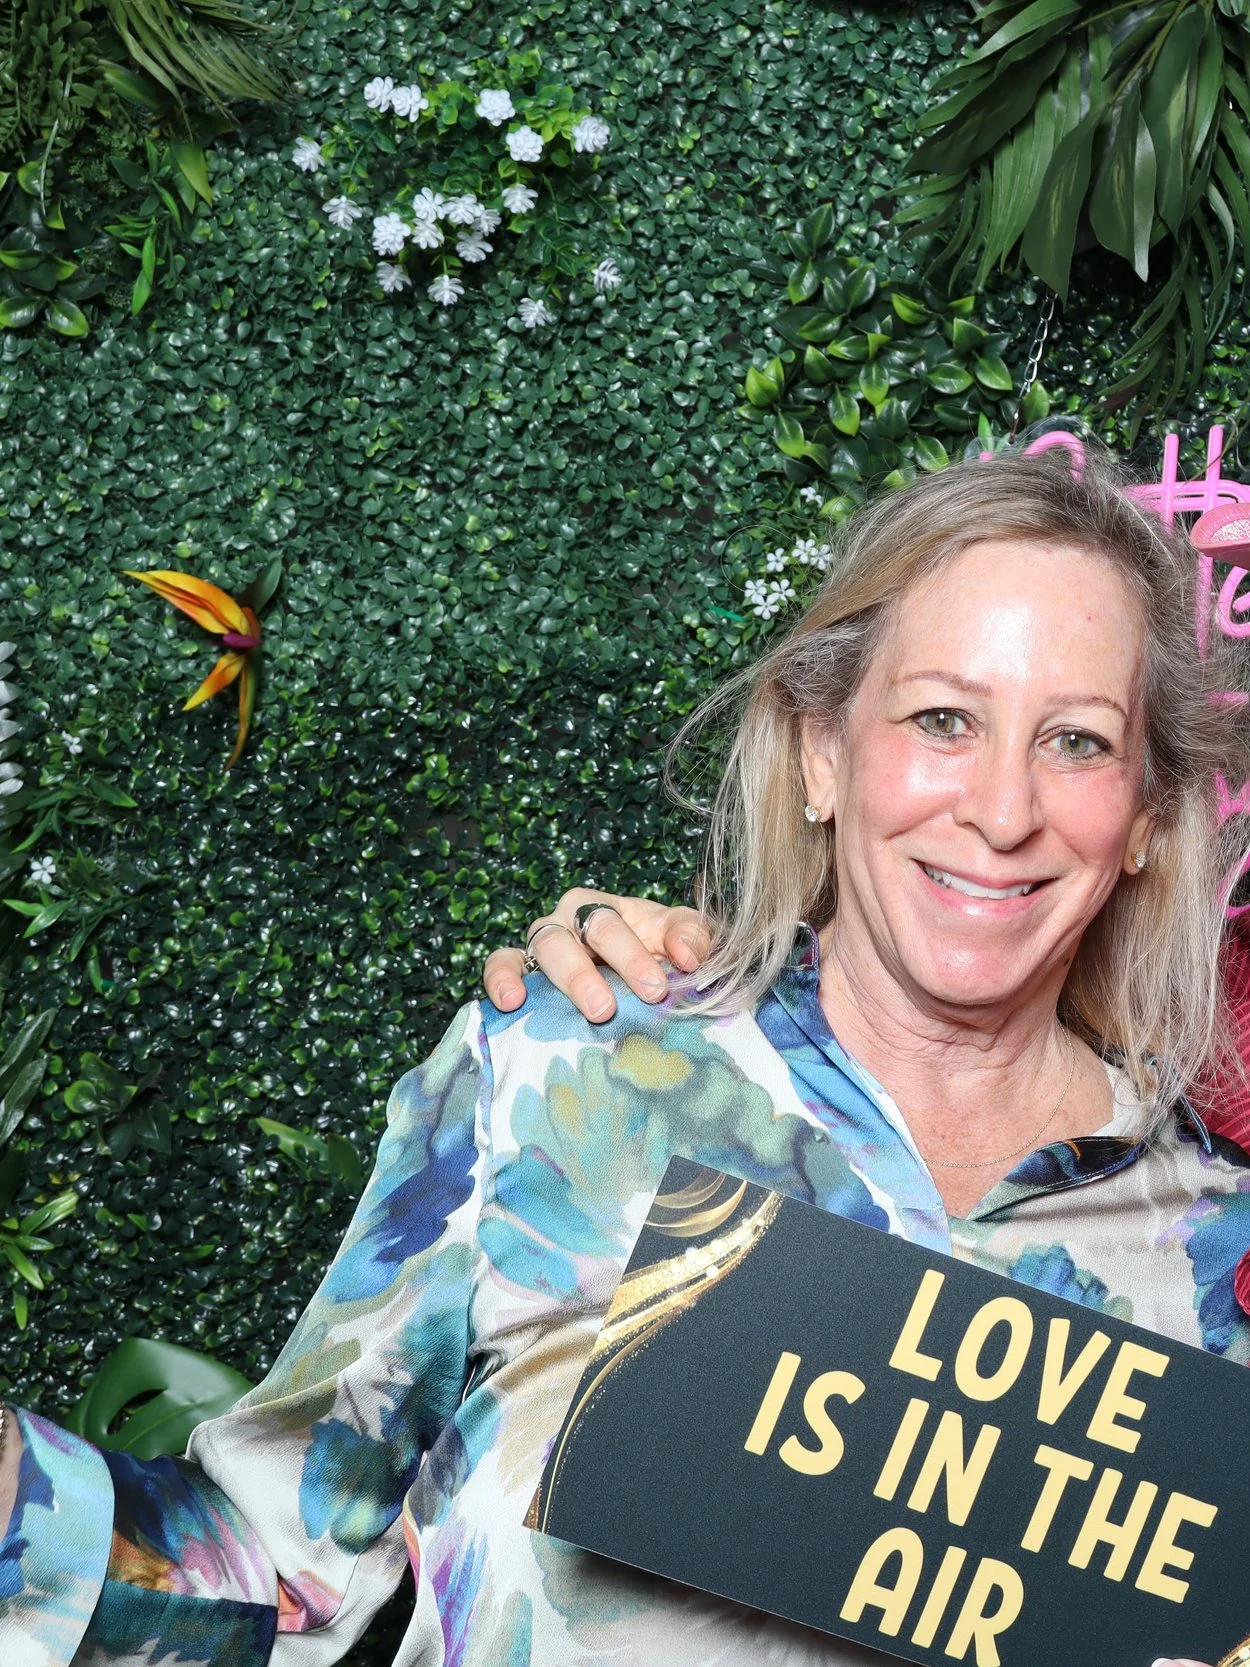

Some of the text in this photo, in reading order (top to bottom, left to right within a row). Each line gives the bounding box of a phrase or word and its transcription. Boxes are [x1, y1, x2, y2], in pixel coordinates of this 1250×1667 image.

[889, 1269, 1170, 1454] LOVE
[744, 1352, 1218, 1603] IS IN THE
[839, 1527, 1024, 1667] AIR
